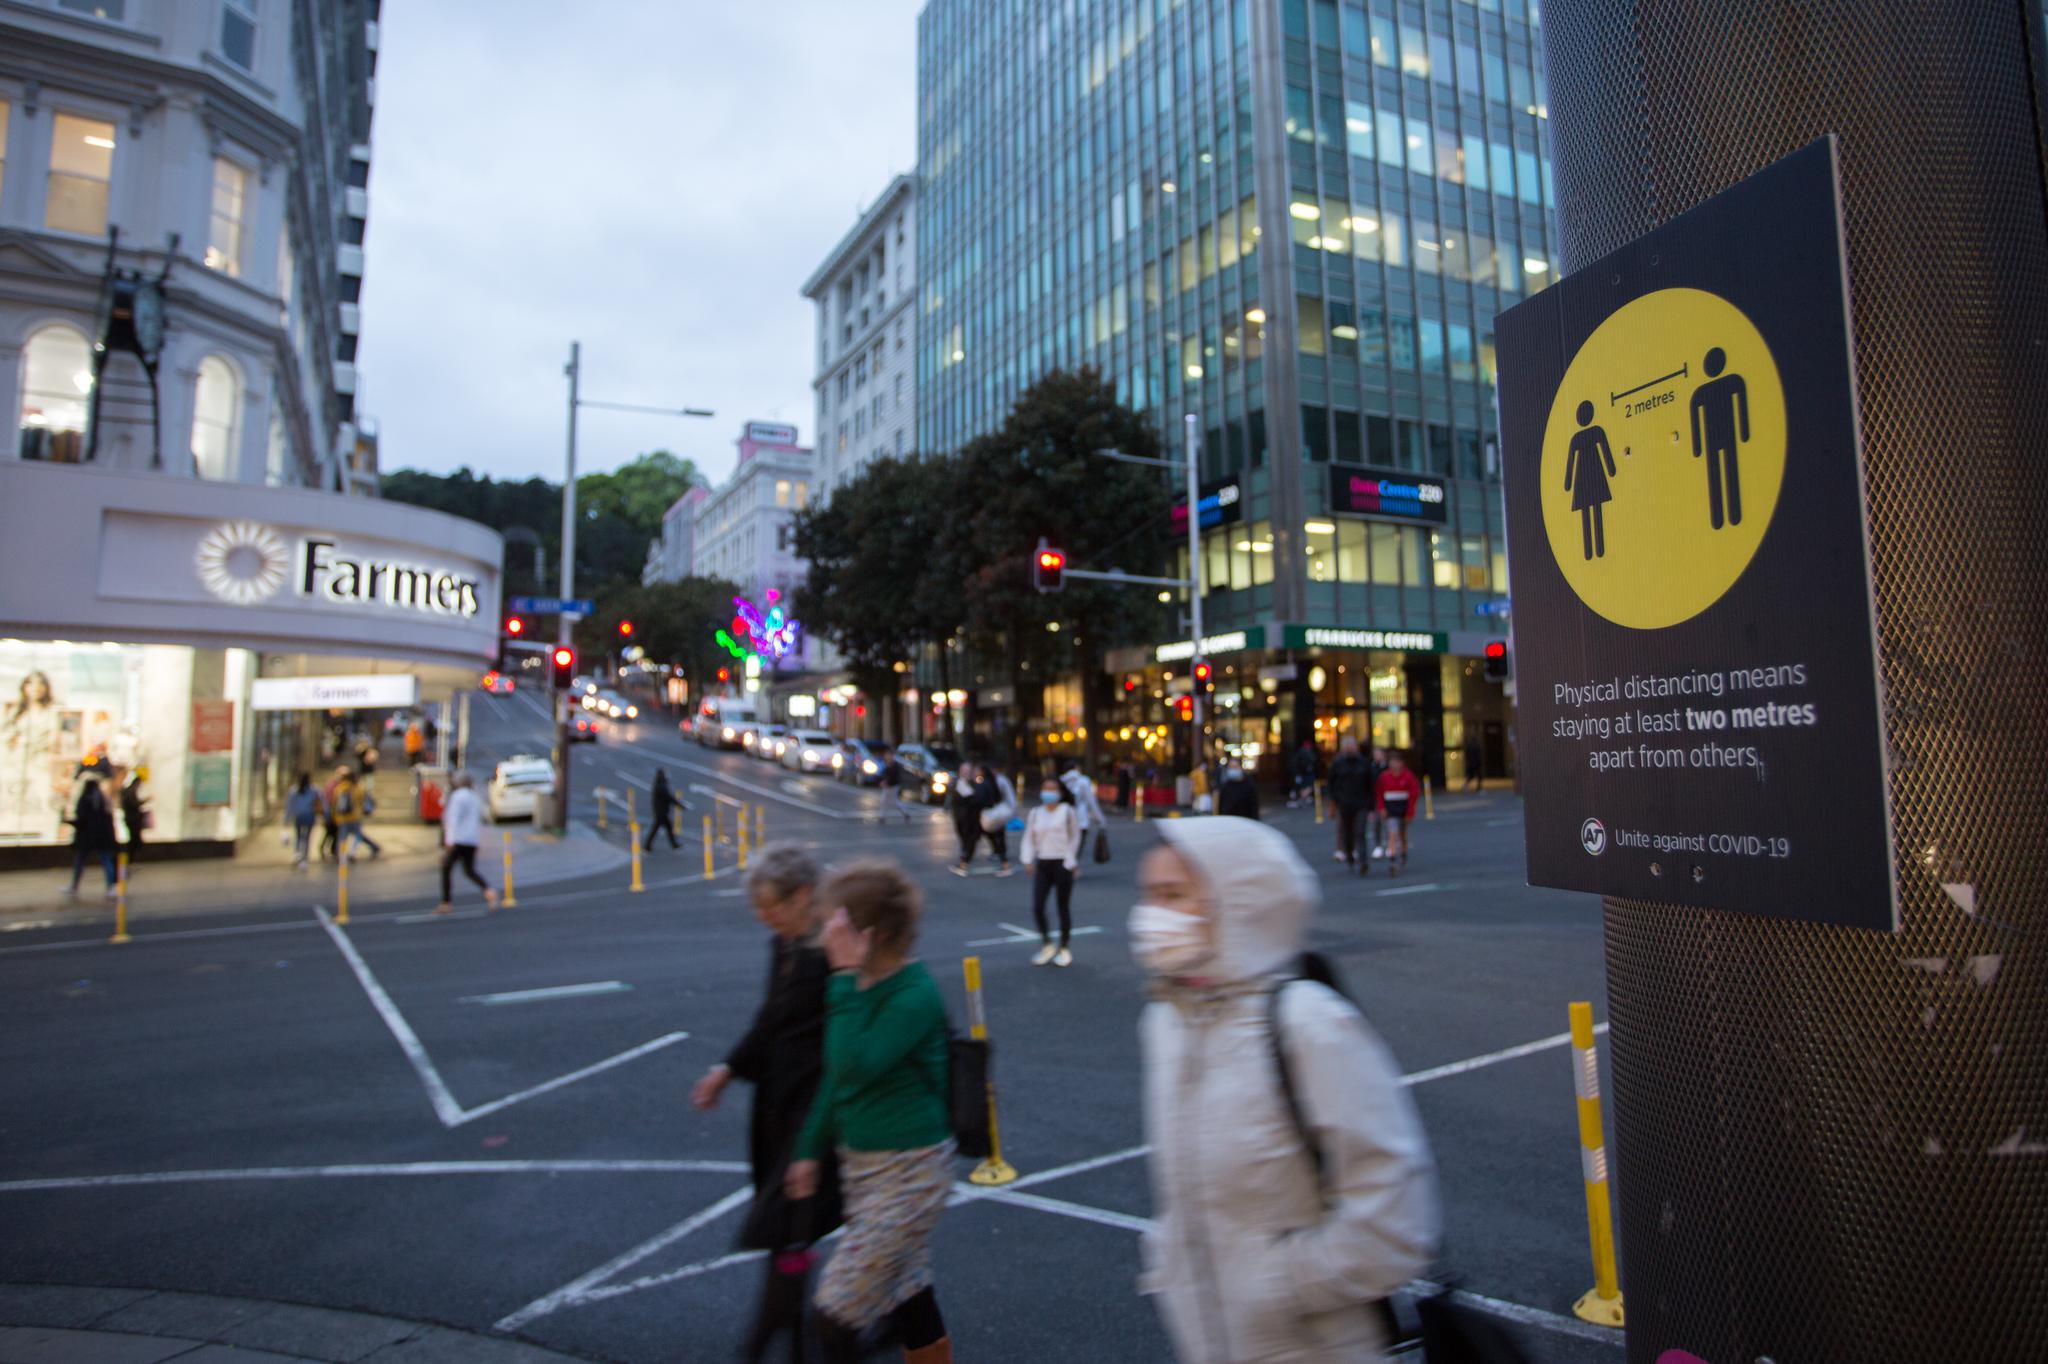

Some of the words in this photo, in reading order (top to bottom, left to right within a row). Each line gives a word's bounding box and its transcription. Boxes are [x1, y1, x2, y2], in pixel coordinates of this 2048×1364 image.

[1625, 404, 1632, 418] 2
[1634, 390, 1675, 415] metres
[304, 539, 480, 618] Farmers
[1554, 677, 1620, 708] Physical
[1624, 669, 1723, 699] distancing
[1730, 663, 1806, 688] means
[1552, 711, 1610, 740] staying
[1614, 712, 1632, 735] at
[1636, 709, 1681, 733] least
[1686, 707, 1726, 731] two
[1732, 702, 1815, 729] metres
[1589, 746, 1635, 772] apart
[1639, 743, 1685, 768] from
[1615, 829, 1650, 849] Unite
[1652, 833, 1705, 853] against
[1708, 833, 1790, 859] COVID-19
